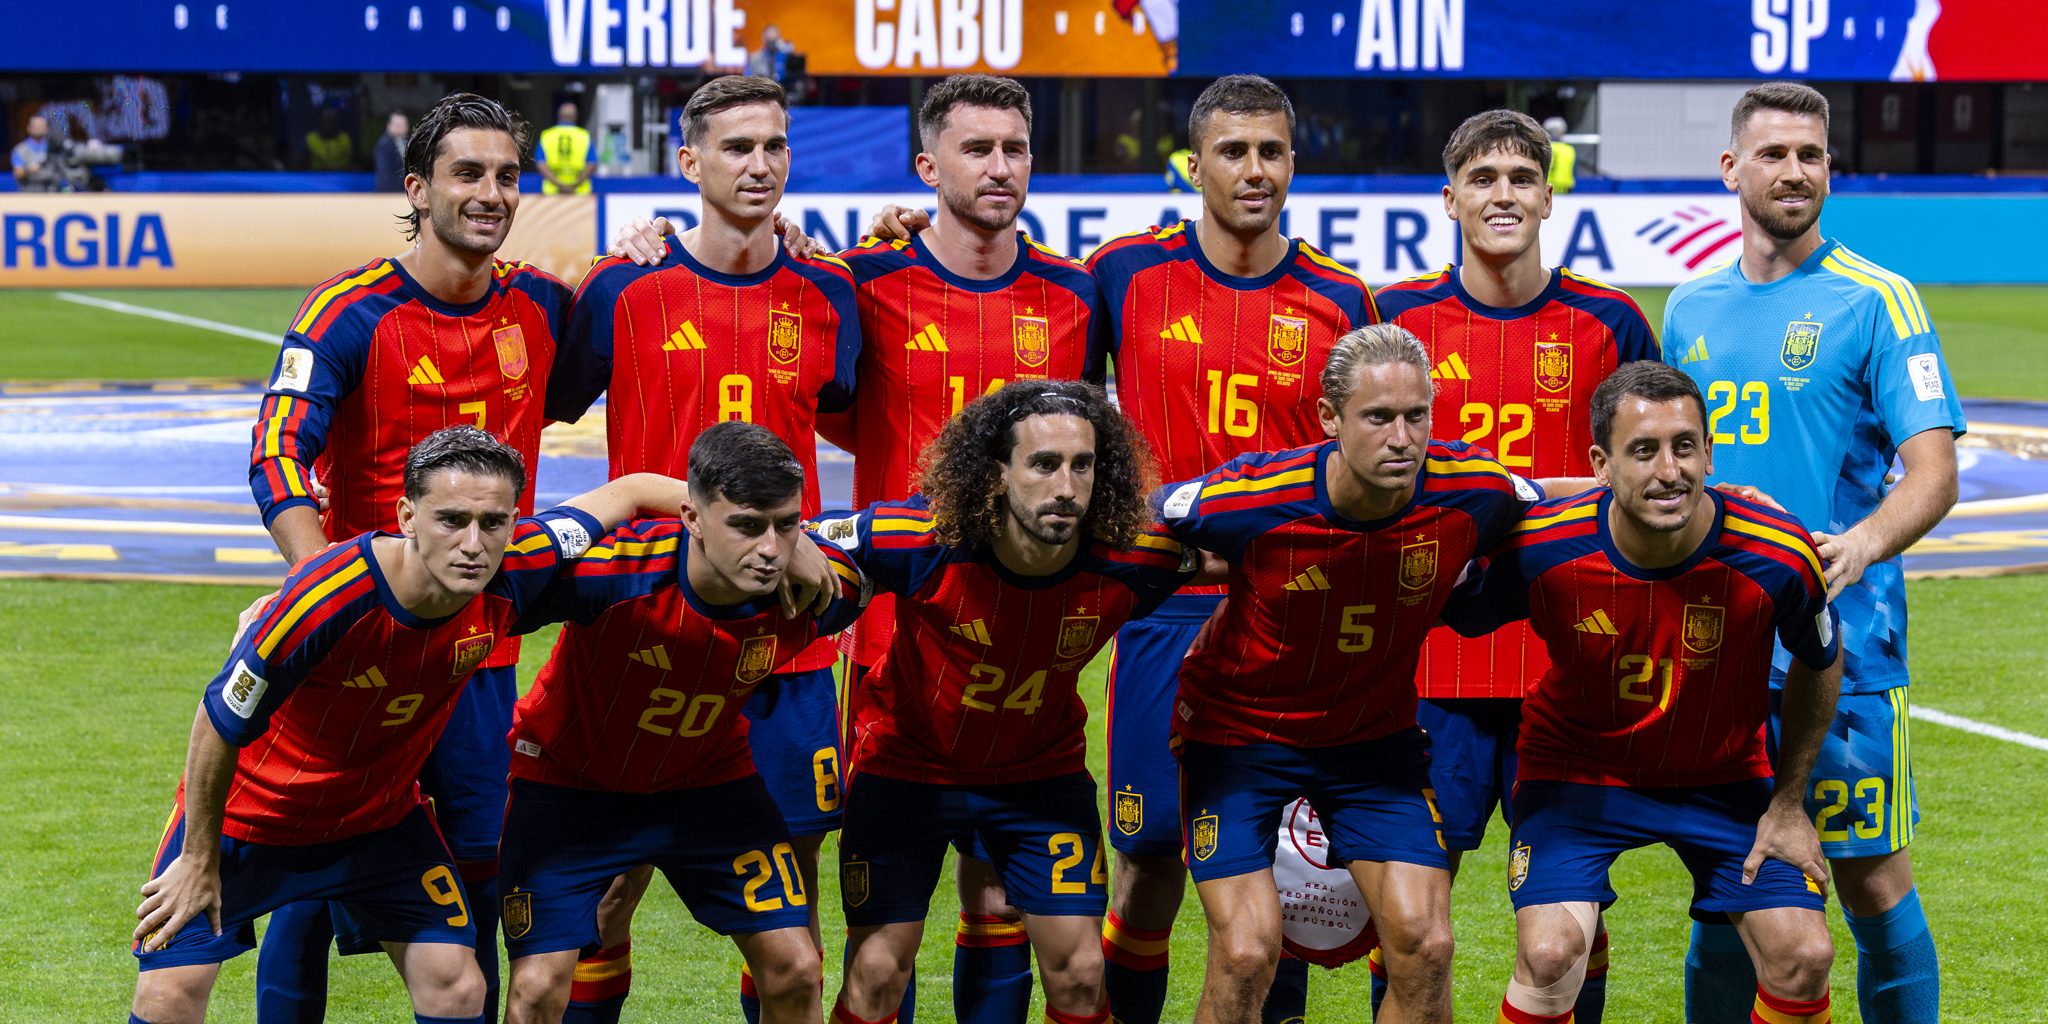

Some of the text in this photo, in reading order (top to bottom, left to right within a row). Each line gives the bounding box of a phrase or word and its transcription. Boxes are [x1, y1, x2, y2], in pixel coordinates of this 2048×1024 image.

[547, 0, 748, 67] VERDE
[855, 0, 1024, 69] CABO
[3, 212, 175, 268] RGIA
[718, 374, 753, 424] 8
[949, 376, 1006, 420] 1
[1207, 369, 1259, 438] 16
[1707, 380, 1770, 445] 23
[1459, 402, 1534, 467] 22
[1337, 604, 1376, 653] 5
[381, 693, 425, 727] 9
[960, 663, 1048, 716] 24
[1618, 654, 1673, 712] 21
[637, 687, 726, 738] 20
[812, 746, 840, 813] 8
[1815, 776, 1886, 842] 23
[420, 864, 469, 928] 9
[732, 842, 808, 913] 20
[1304, 881, 1336, 893] REAL
[1284, 902, 1350, 918] ESPAÑOLA
[1303, 916, 1352, 930] FÚTBOL
